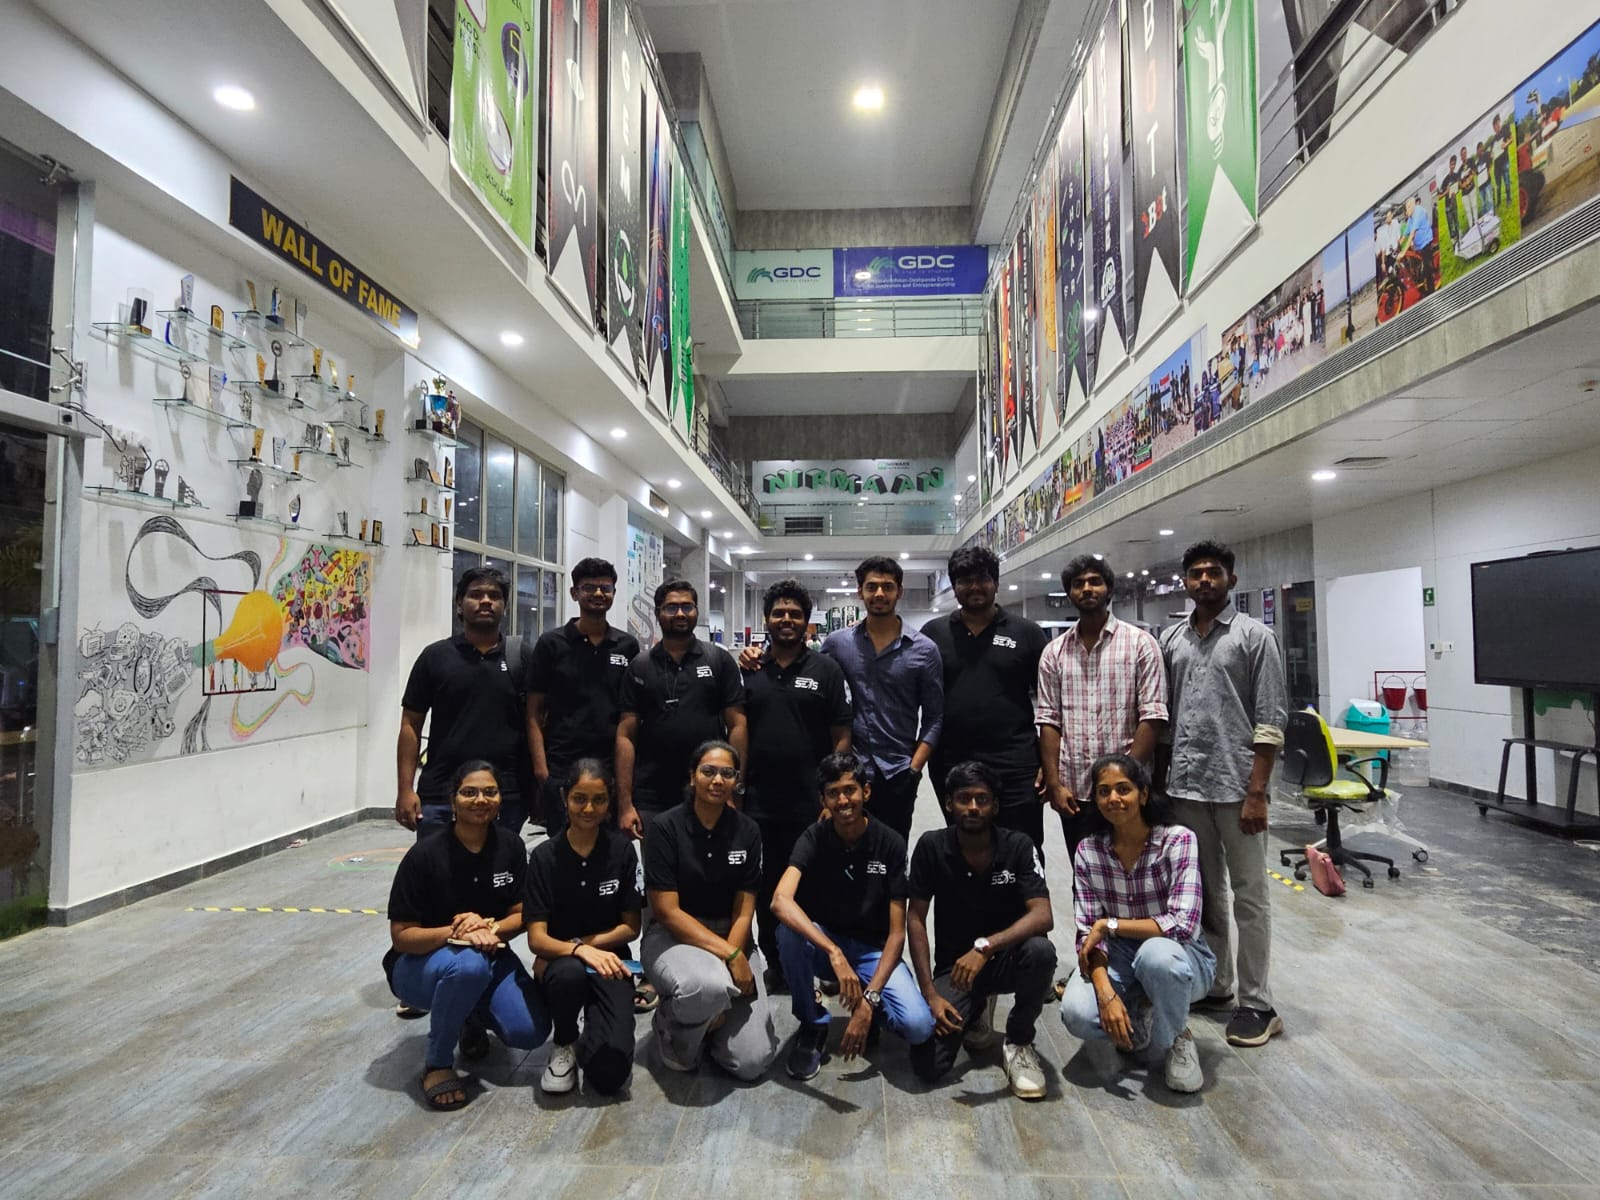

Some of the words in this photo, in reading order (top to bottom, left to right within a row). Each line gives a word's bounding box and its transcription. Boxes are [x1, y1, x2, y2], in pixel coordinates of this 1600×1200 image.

[261, 208, 323, 276] WALL
[328, 259, 354, 294] OF
[358, 278, 401, 329] FAME
[773, 266, 821, 279] GDC
[898, 255, 955, 269] GDC
[762, 467, 945, 495] NIRMAAN
